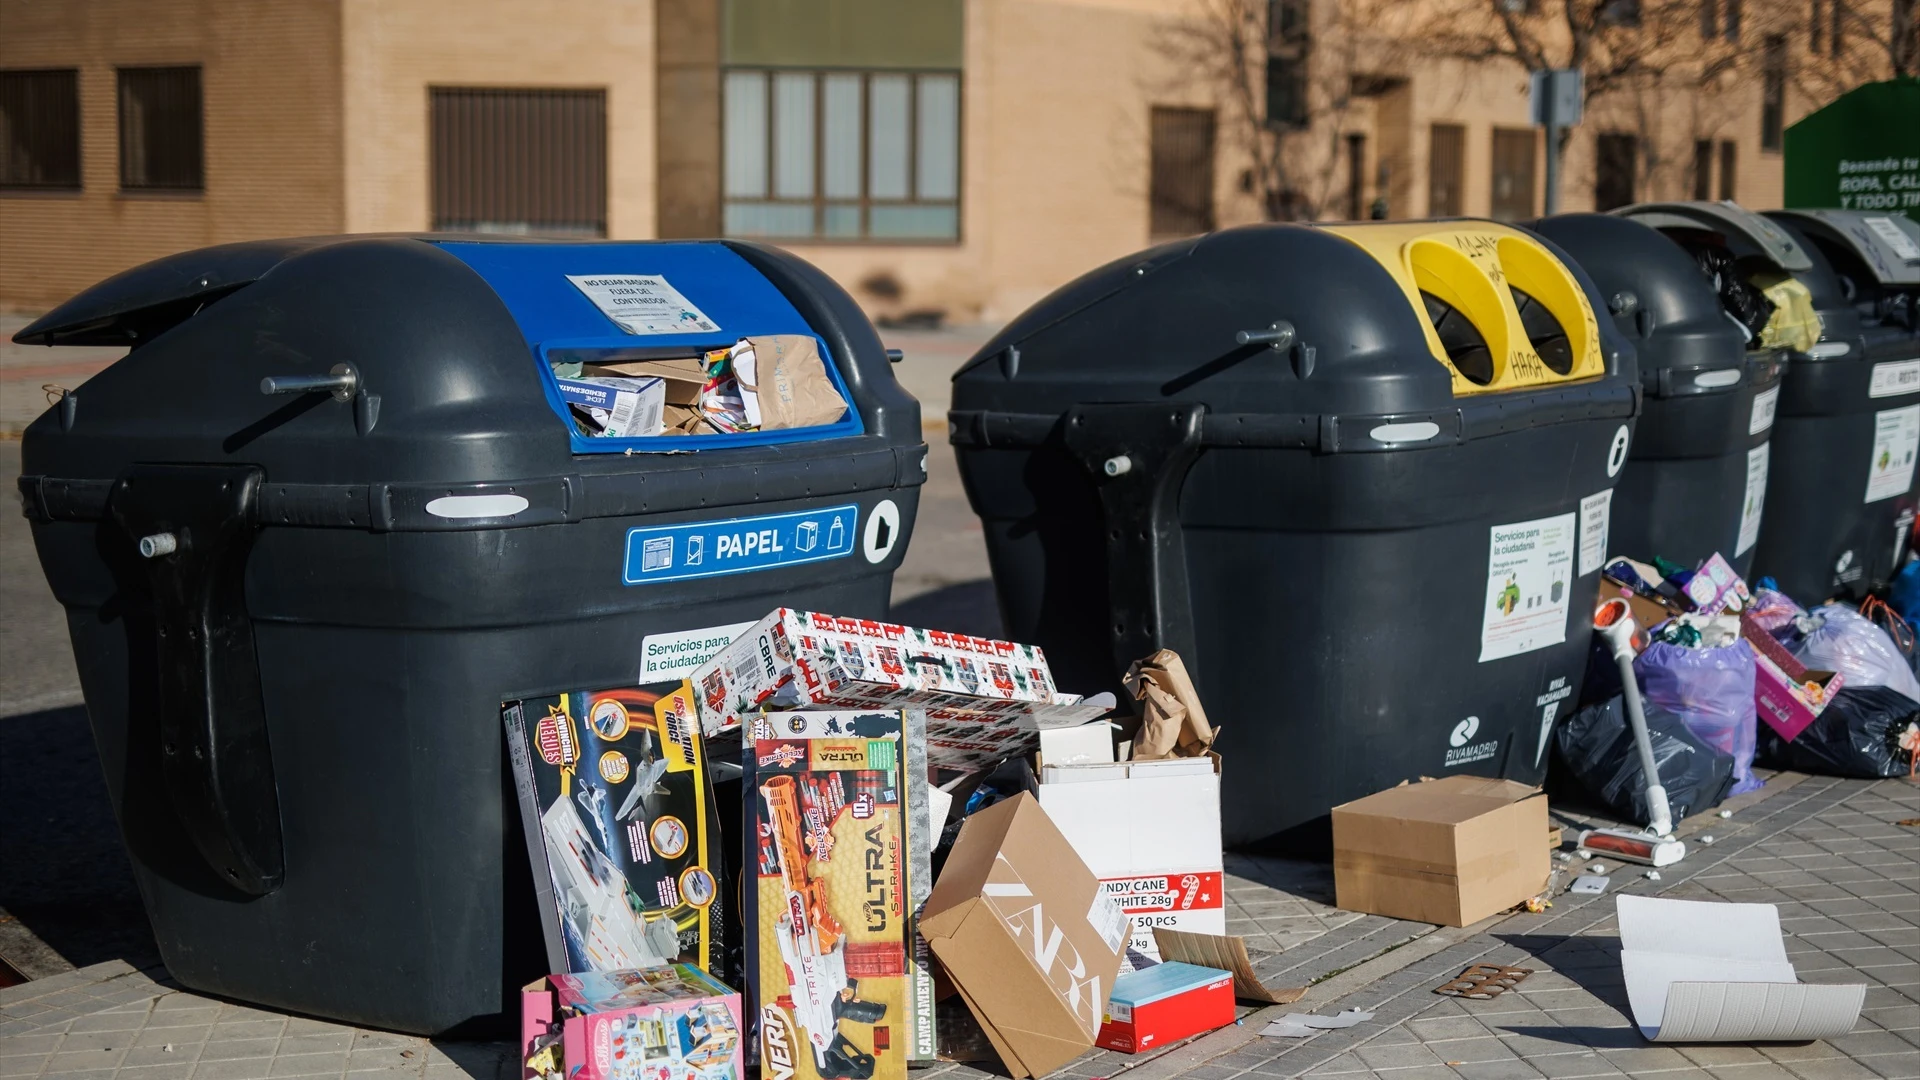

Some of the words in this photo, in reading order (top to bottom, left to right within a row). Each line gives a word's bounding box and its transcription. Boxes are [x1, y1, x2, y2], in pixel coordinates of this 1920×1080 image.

[1888, 174, 1920, 190] CAL
[1856, 193, 1898, 210] TODO
[585, 395, 606, 405] LECHE
[716, 529, 784, 559] PAPEL
[1495, 529, 1525, 543] Servicios
[1526, 528, 1540, 541] para
[1494, 545, 1501, 555] la
[648, 639, 703, 656] Servicios
[704, 636, 730, 651] para
[647, 660, 657, 672] la
[758, 635, 777, 679] CBRE
[1549, 676, 1566, 691] RIVAS
[673, 696, 687, 721] USS
[664, 710, 681, 744] FORCE
[540, 718, 562, 765] HEROES
[556, 715, 573, 764] INVINCIBLE
[677, 719, 696, 765] AVIATION
[818, 753, 864, 762] ULTRA
[1446, 740, 1498, 761] RIVAMADRID
[865, 821, 887, 932] ULTRA
[889, 840, 899, 912] STRIKE
[1106, 882, 1131, 892] NDY
[1133, 880, 1165, 891] CANE
[1151, 895, 1171, 907] 28g
[1137, 916, 1153, 927] 50
[1156, 916, 1176, 926] PCS
[982, 851, 1102, 1039] ZARA
[1136, 938, 1147, 948] kg
[803, 956, 820, 1006] STRIKE
[916, 960, 931, 1055] CAMPAMENTO
[761, 1006, 795, 1080] NERF
